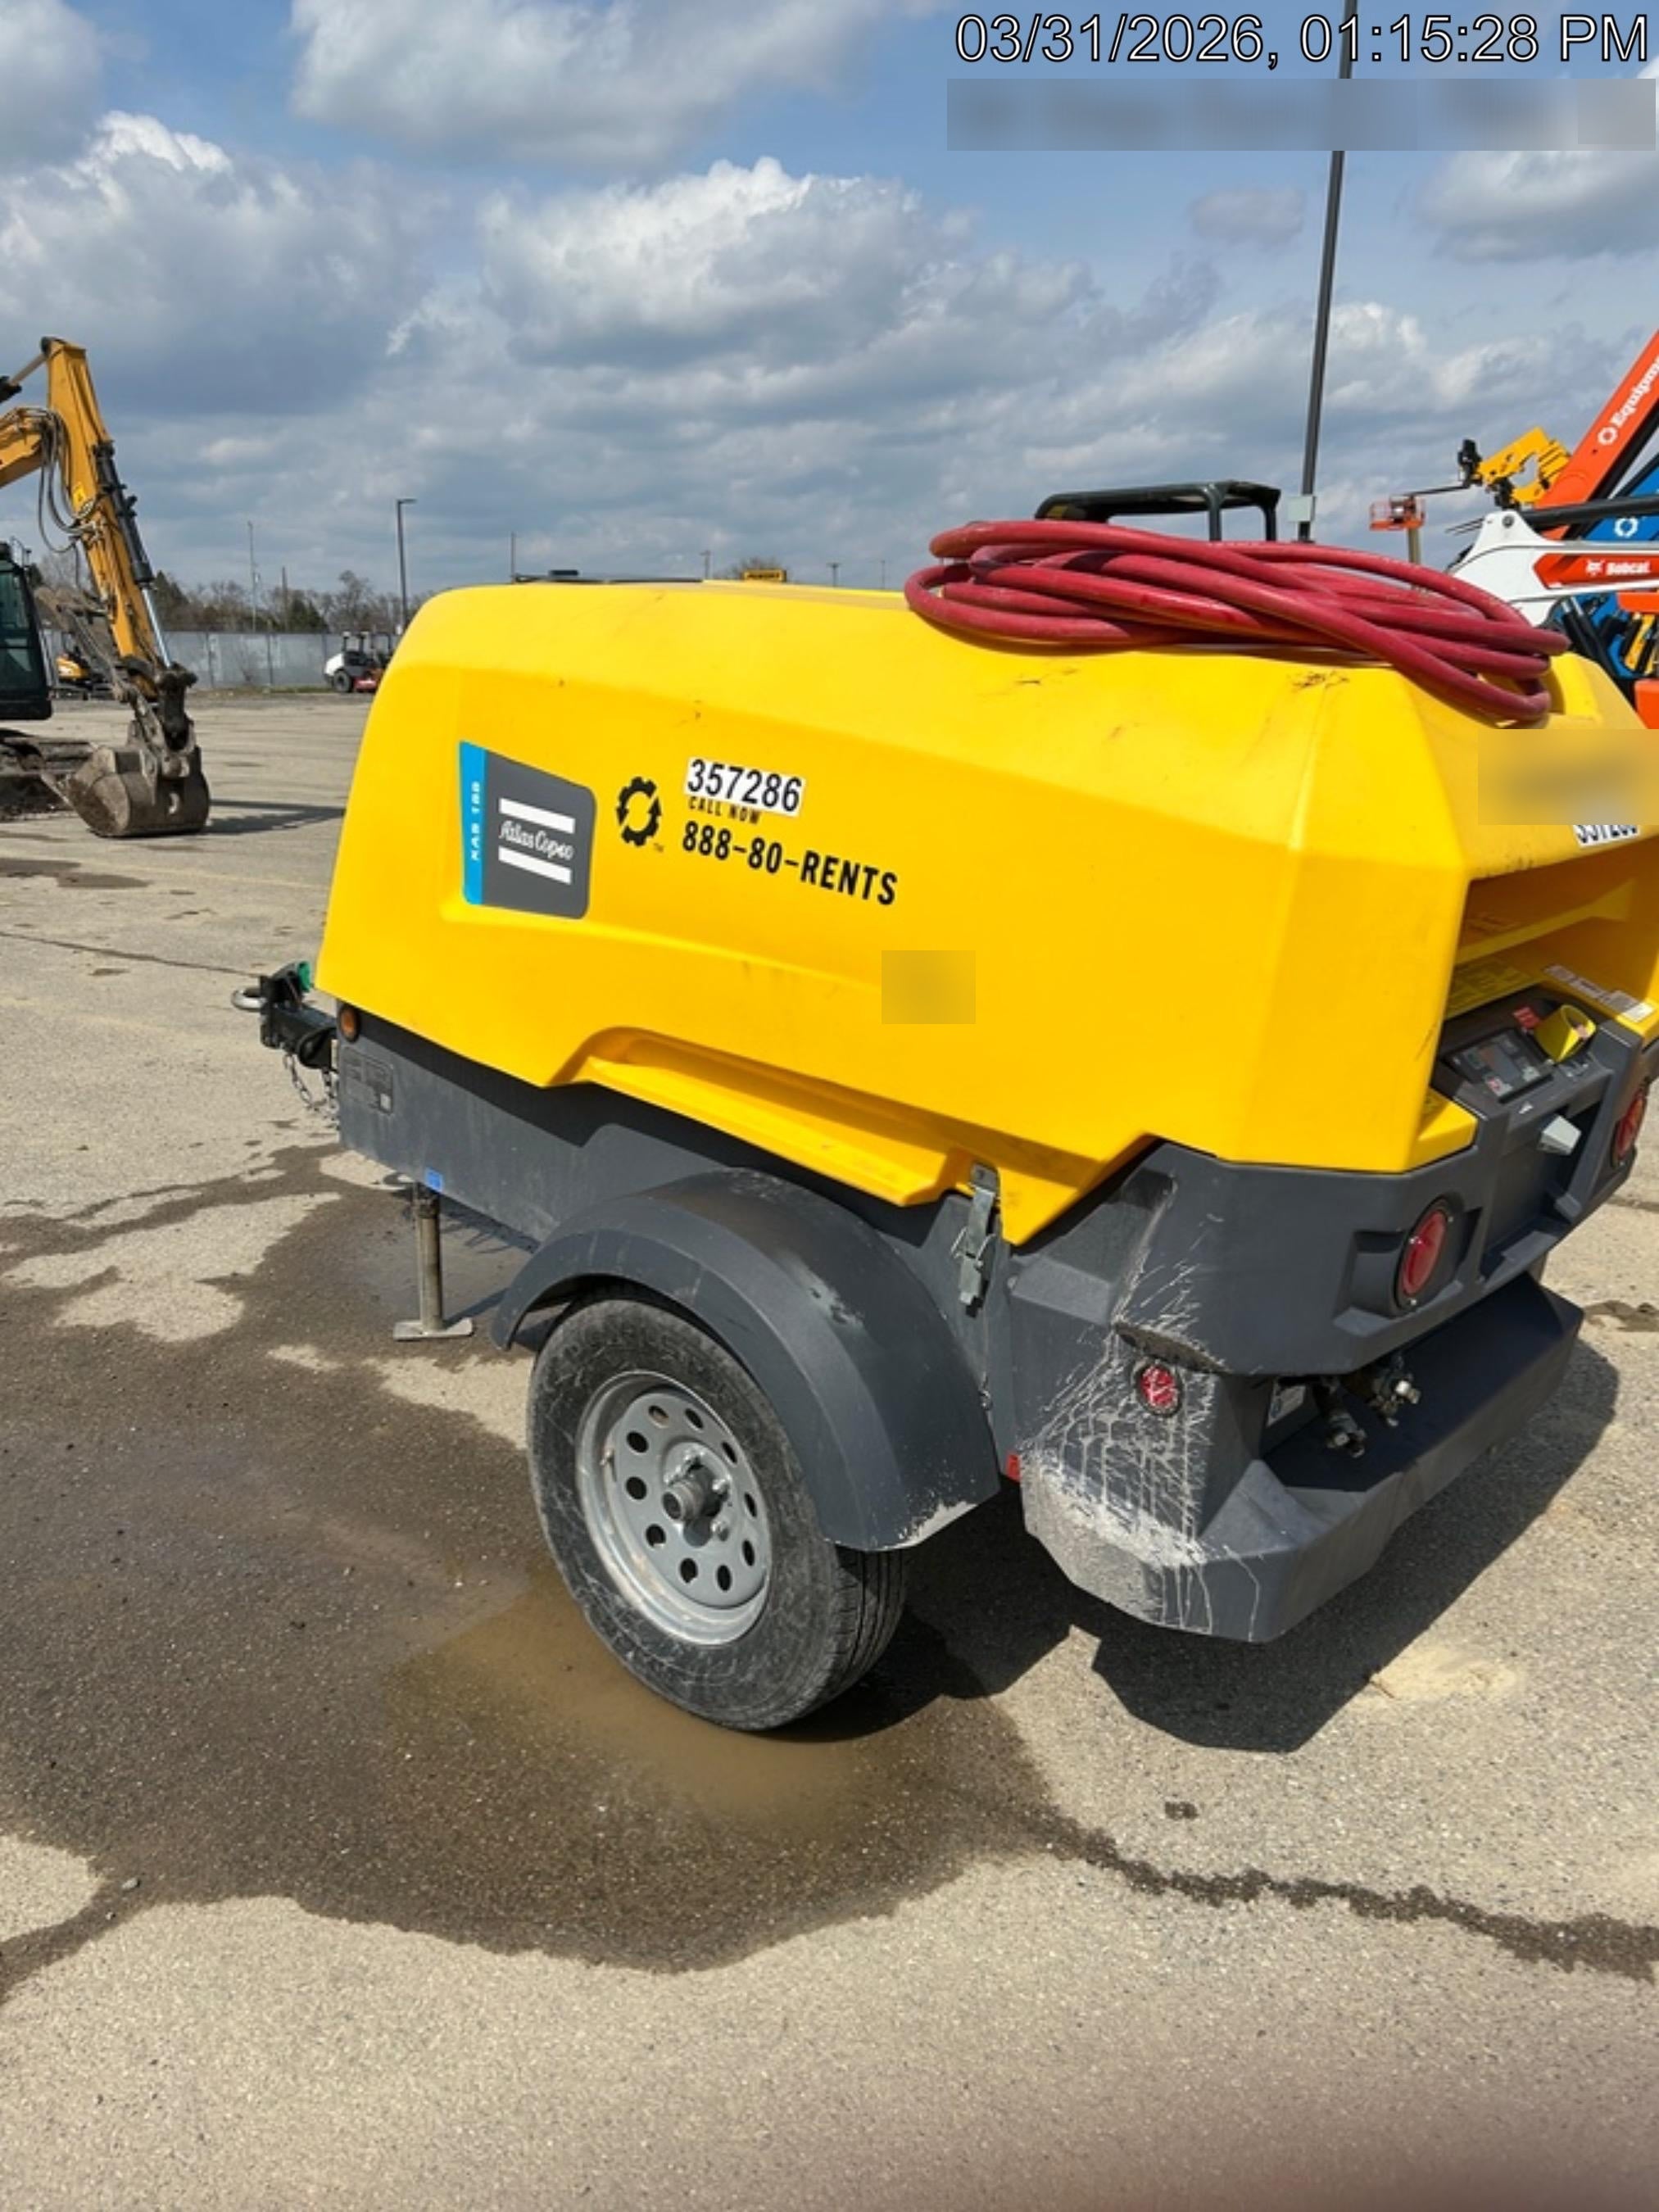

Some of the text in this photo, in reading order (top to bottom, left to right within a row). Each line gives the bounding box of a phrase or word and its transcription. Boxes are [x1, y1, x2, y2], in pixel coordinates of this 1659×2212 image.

[687, 759, 802, 812] 357286
[688, 796, 760, 824] CALL NOW
[498, 820, 574, 861] Atlas Copco
[682, 821, 898, 905] 888-80-RENTS
